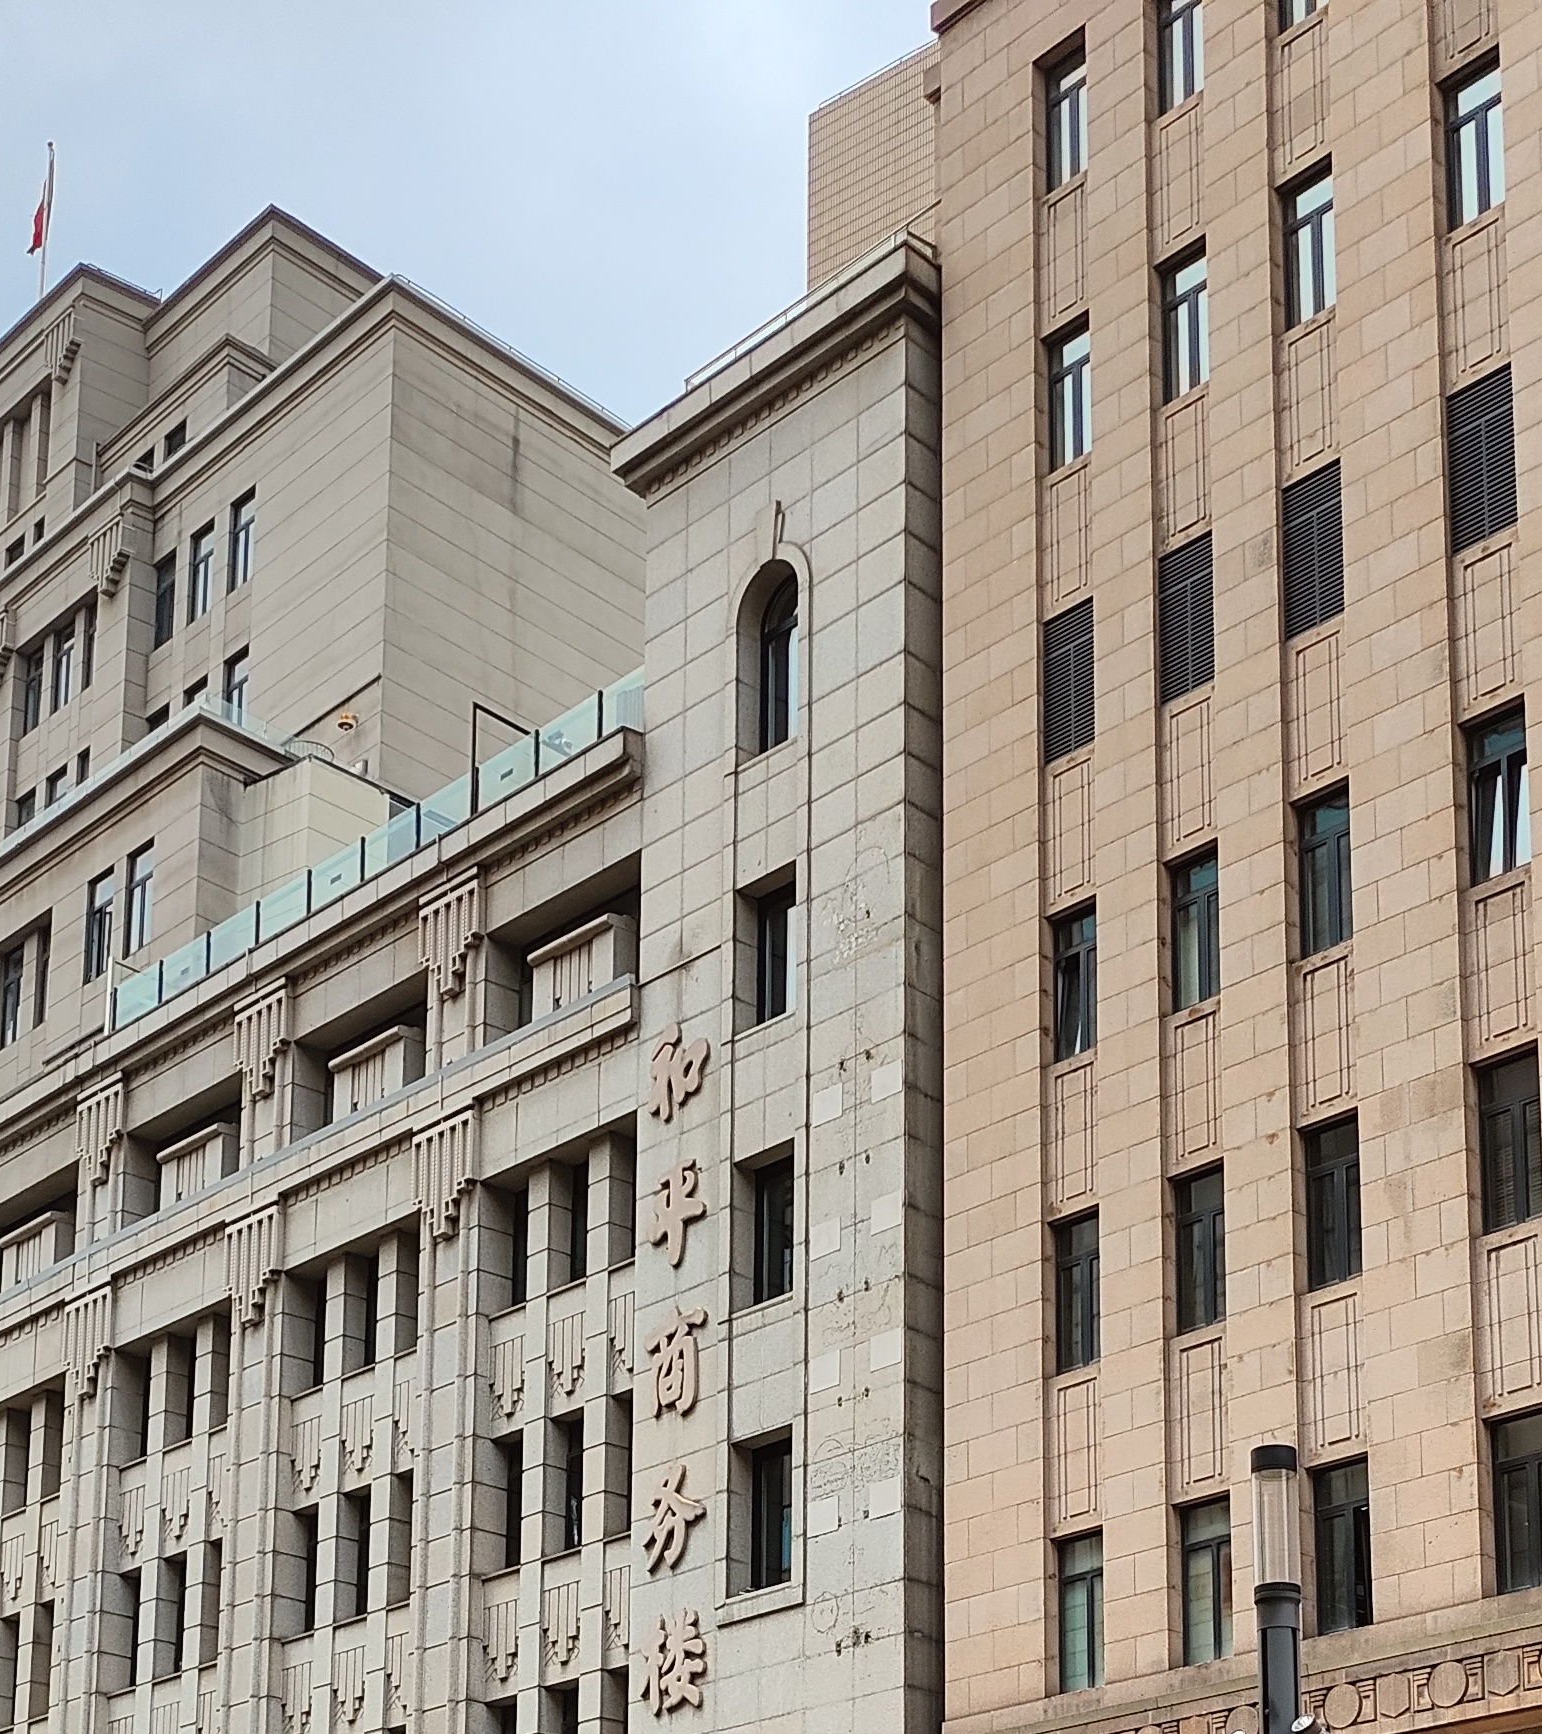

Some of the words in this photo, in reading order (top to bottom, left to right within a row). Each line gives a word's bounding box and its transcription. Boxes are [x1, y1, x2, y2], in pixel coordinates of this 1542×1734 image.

[641, 1022, 711, 1717] 和平商务楼
